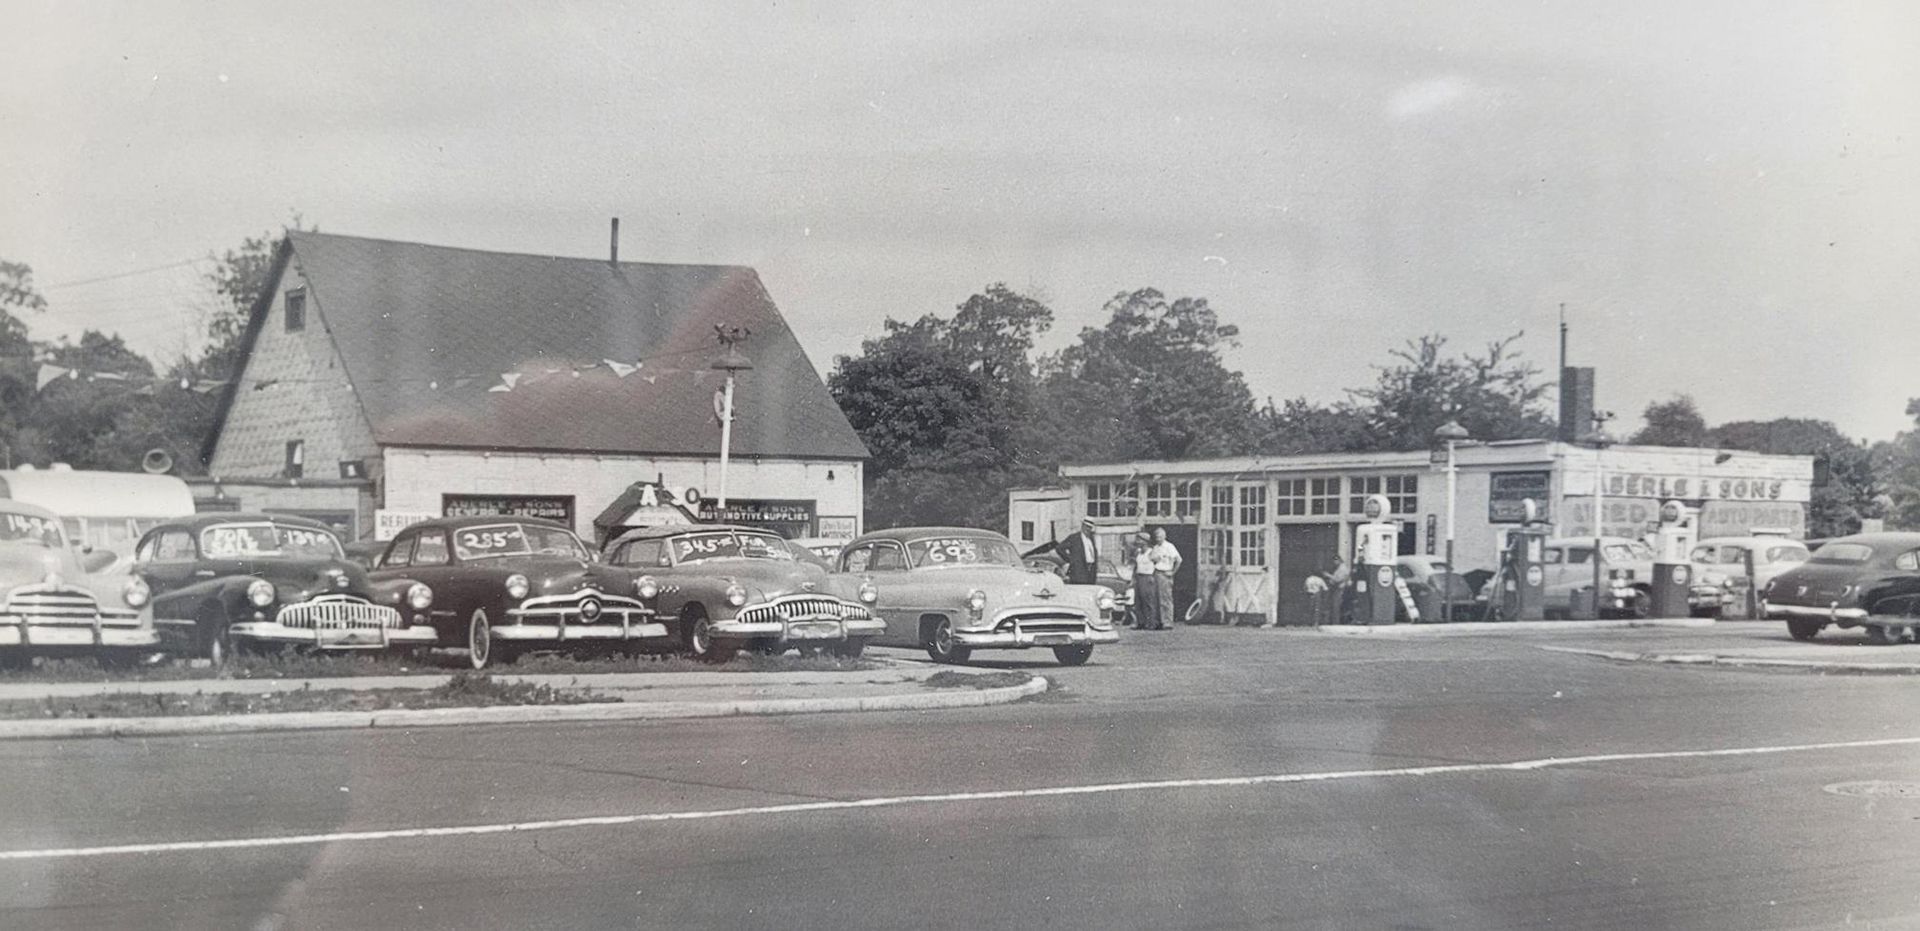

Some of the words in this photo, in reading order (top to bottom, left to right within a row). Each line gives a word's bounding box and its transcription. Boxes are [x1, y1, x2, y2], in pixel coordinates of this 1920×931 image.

[1718, 480, 1782, 499] SONS
[513, 508, 566, 518] REPAIRS
[763, 511, 810, 521] SUPPLIES
[213, 528, 249, 541] FOR
